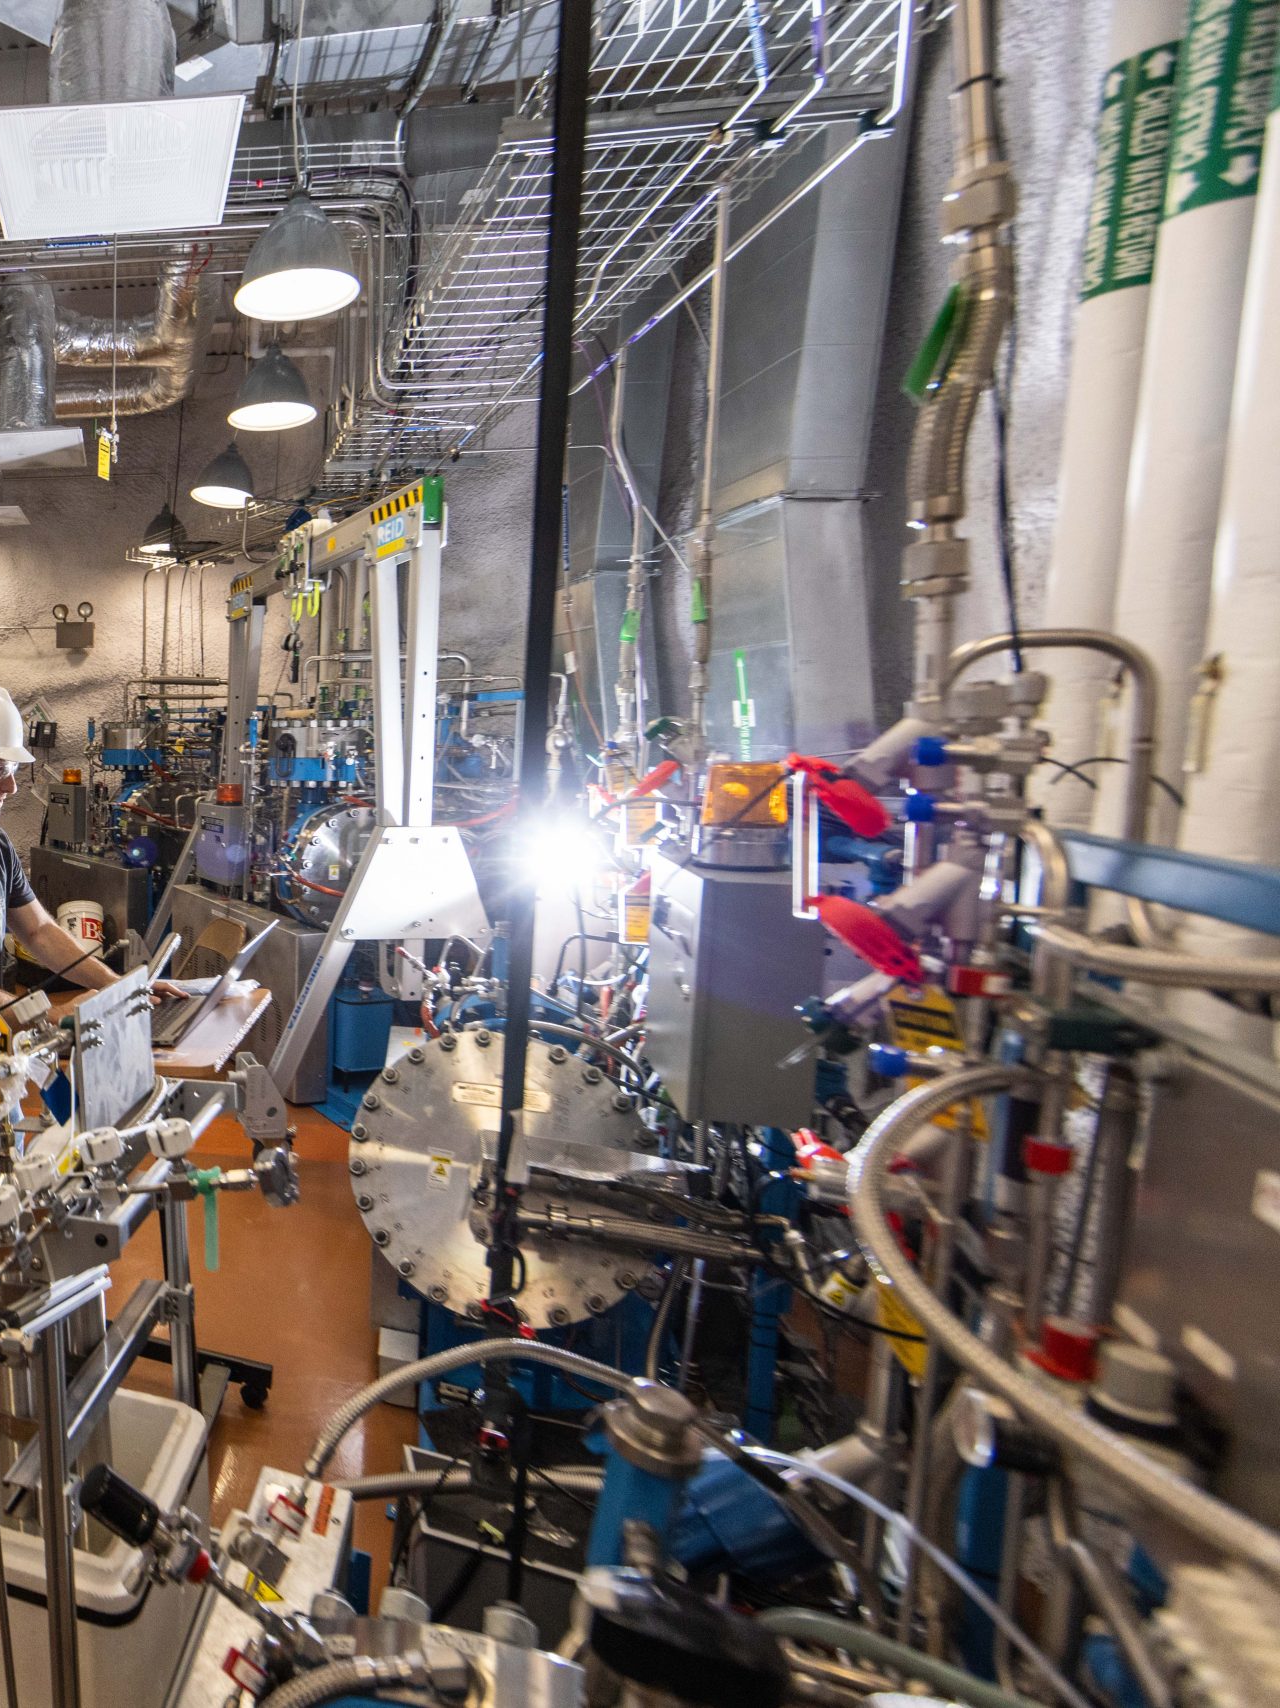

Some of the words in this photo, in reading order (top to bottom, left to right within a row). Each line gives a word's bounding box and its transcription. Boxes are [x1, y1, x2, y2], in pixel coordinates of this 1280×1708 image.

[1128, 85, 1175, 157] CHILLED
[1120, 154, 1168, 215] WATER
[1111, 209, 1160, 282] RETURN
